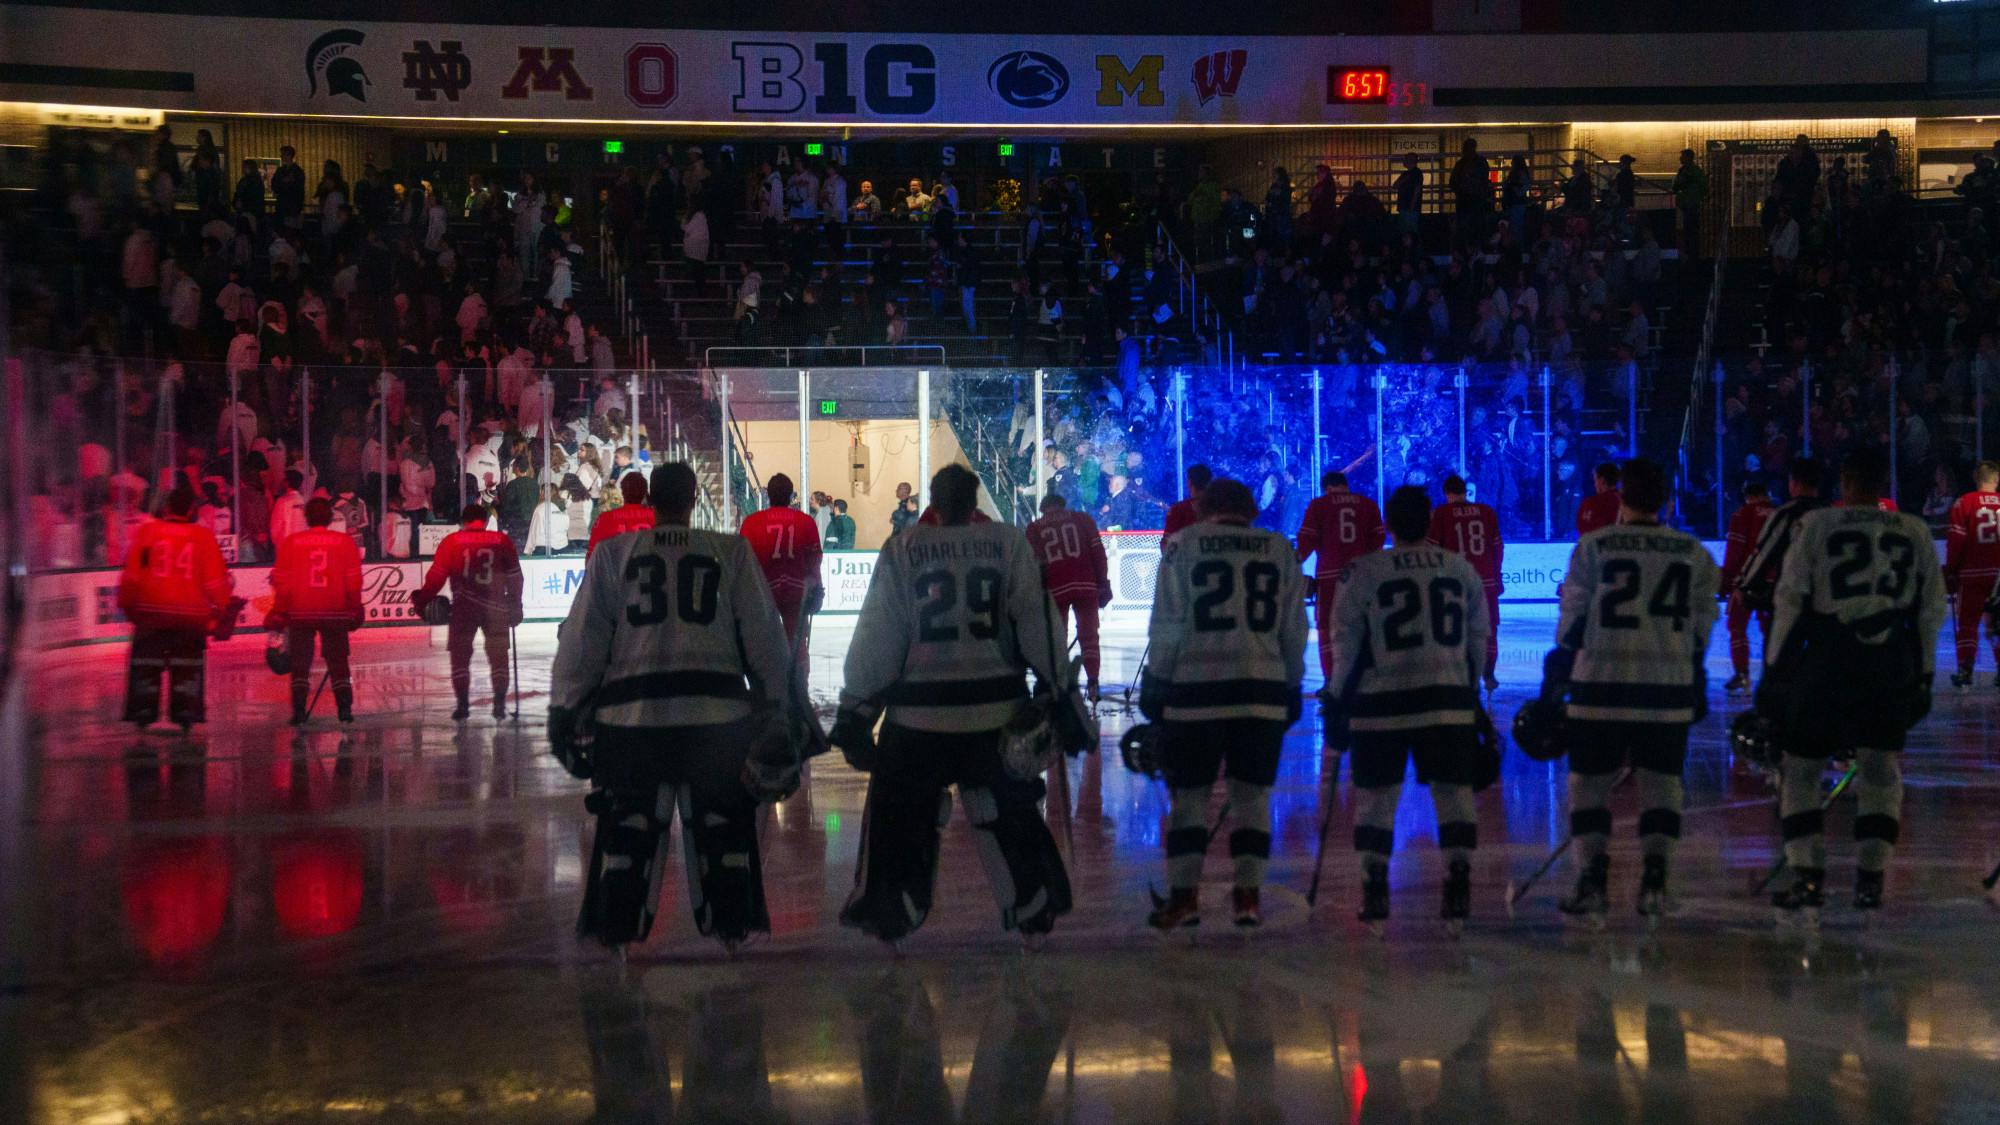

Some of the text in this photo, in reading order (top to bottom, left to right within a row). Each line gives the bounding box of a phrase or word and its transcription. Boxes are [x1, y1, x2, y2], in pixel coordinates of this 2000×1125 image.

[502, 47, 593, 100] M
[624, 43, 679, 108] O
[1096, 55, 1164, 106] M
[1191, 50, 1247, 107] W
[1000, 144, 1013, 155] EXIT
[1394, 141, 1438, 150] TICKETS
[821, 401, 836, 414] EXIT
[766, 524, 795, 559] 71
[1041, 523, 1101, 563] 20
[1340, 508, 1356, 543] 6
[1455, 519, 1486, 556] 18
[1976, 506, 2000, 544] 2
[152, 540, 193, 579] 34
[310, 549, 328, 587] 2
[462, 548, 495, 584] 13
[908, 541, 1003, 567] CHARLESON
[1392, 551, 1444, 571] KELLY
[1827, 530, 1914, 600] 23
[626, 554, 721, 626] 30
[1501, 568, 1545, 583] ealth
[370, 606, 416, 618] ouse
[915, 566, 1002, 643] 29
[1191, 560, 1280, 631] 28
[1377, 577, 1463, 651] 26
[1601, 558, 1691, 632] 24
